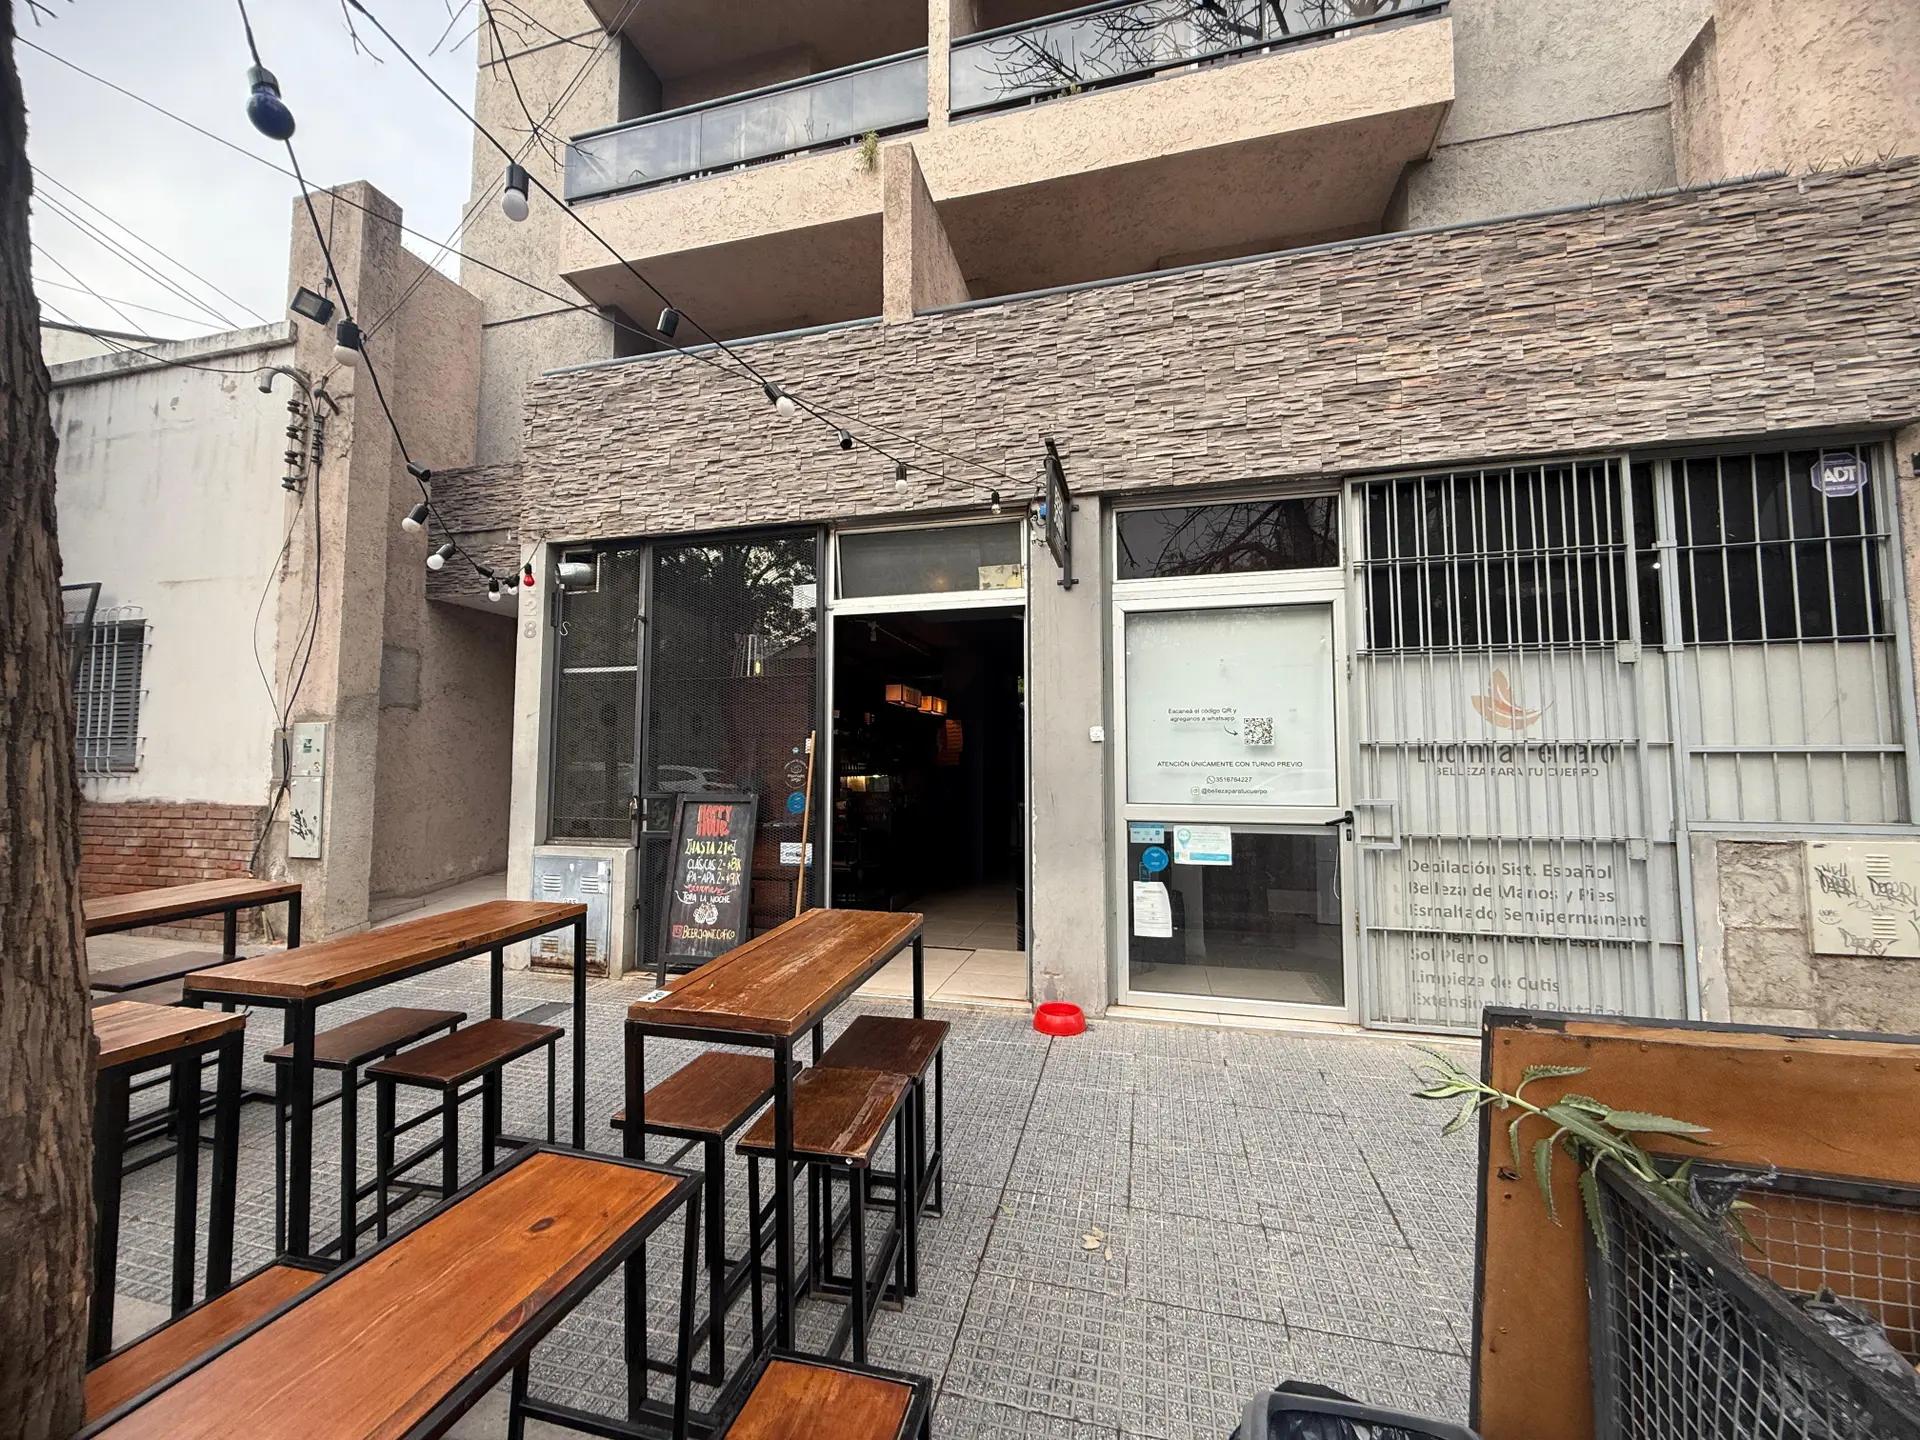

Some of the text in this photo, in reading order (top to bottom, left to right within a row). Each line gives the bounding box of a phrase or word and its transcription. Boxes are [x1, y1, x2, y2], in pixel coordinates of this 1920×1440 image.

[1823, 465, 1857, 482] ADT
[1201, 707, 1221, 716] código
[1221, 707, 1232, 715] QR
[1157, 760, 1190, 768] ATENCIÓN
[1190, 760, 1234, 768] ÚNICAMENTE
[1436, 767, 1599, 777] BELLEZA PARA TU CUERPO
[696, 819, 730, 837] HOUR
[1408, 859, 1612, 879] Depilación Sist. Español
[699, 895, 707, 903] LA
[710, 895, 731, 904] NOCHE
[1408, 881, 1615, 904] Belleza de Manos y Pies
[1409, 903, 1648, 927] Esmaltado Semipermanent
[1411, 947, 1435, 963] Sol
[1411, 969, 1560, 992] Limpieza de Cutis
